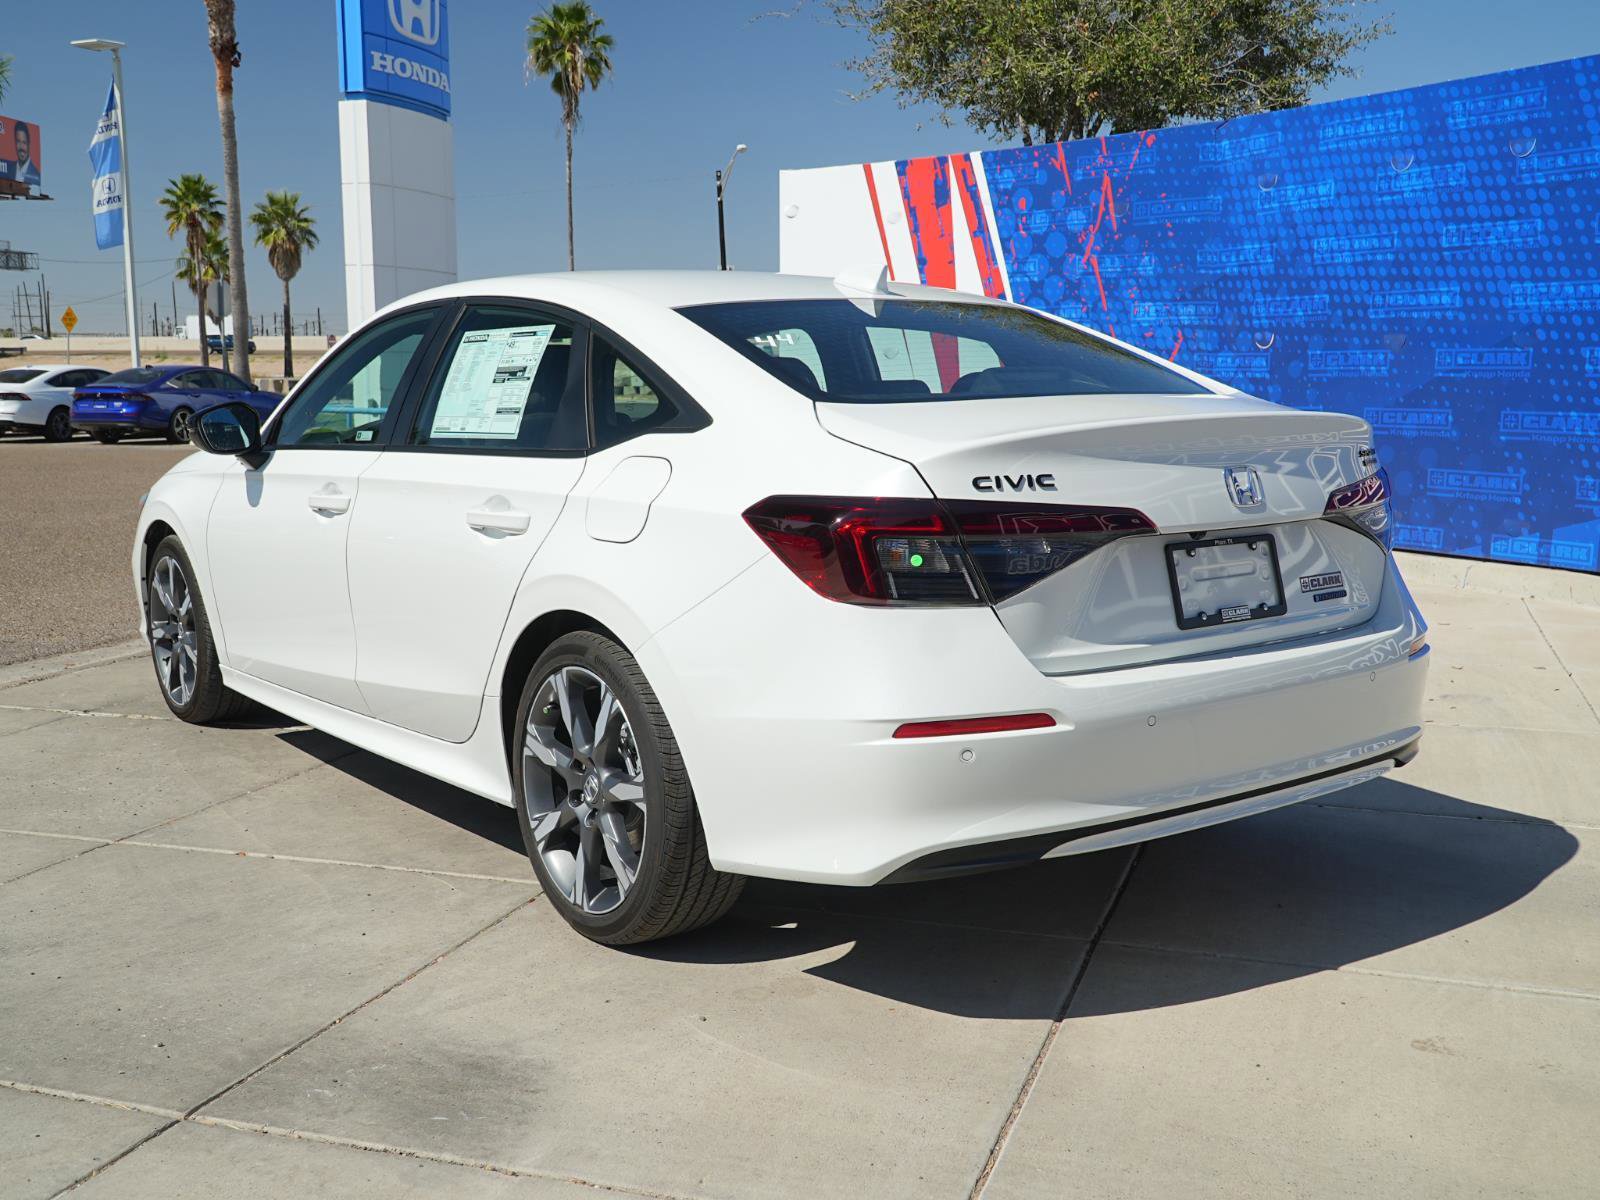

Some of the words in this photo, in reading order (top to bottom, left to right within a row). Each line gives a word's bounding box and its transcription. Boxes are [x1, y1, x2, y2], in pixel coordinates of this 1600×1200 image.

[371, 51, 450, 94] HONDA
[1326, 351, 1387, 367] CLARK
[1457, 352, 1527, 366] CLARK
[1382, 411, 1448, 425] CLARK
[1523, 416, 1600, 431] CLARK
[972, 473, 1057, 491] CIVIC
[1447, 474, 1518, 490] CLARK
[1398, 528, 1441, 546] ARK
[1512, 540, 1588, 561] CLARK
[1310, 574, 1341, 588] CLARK
[1228, 607, 1249, 616] CLARK
